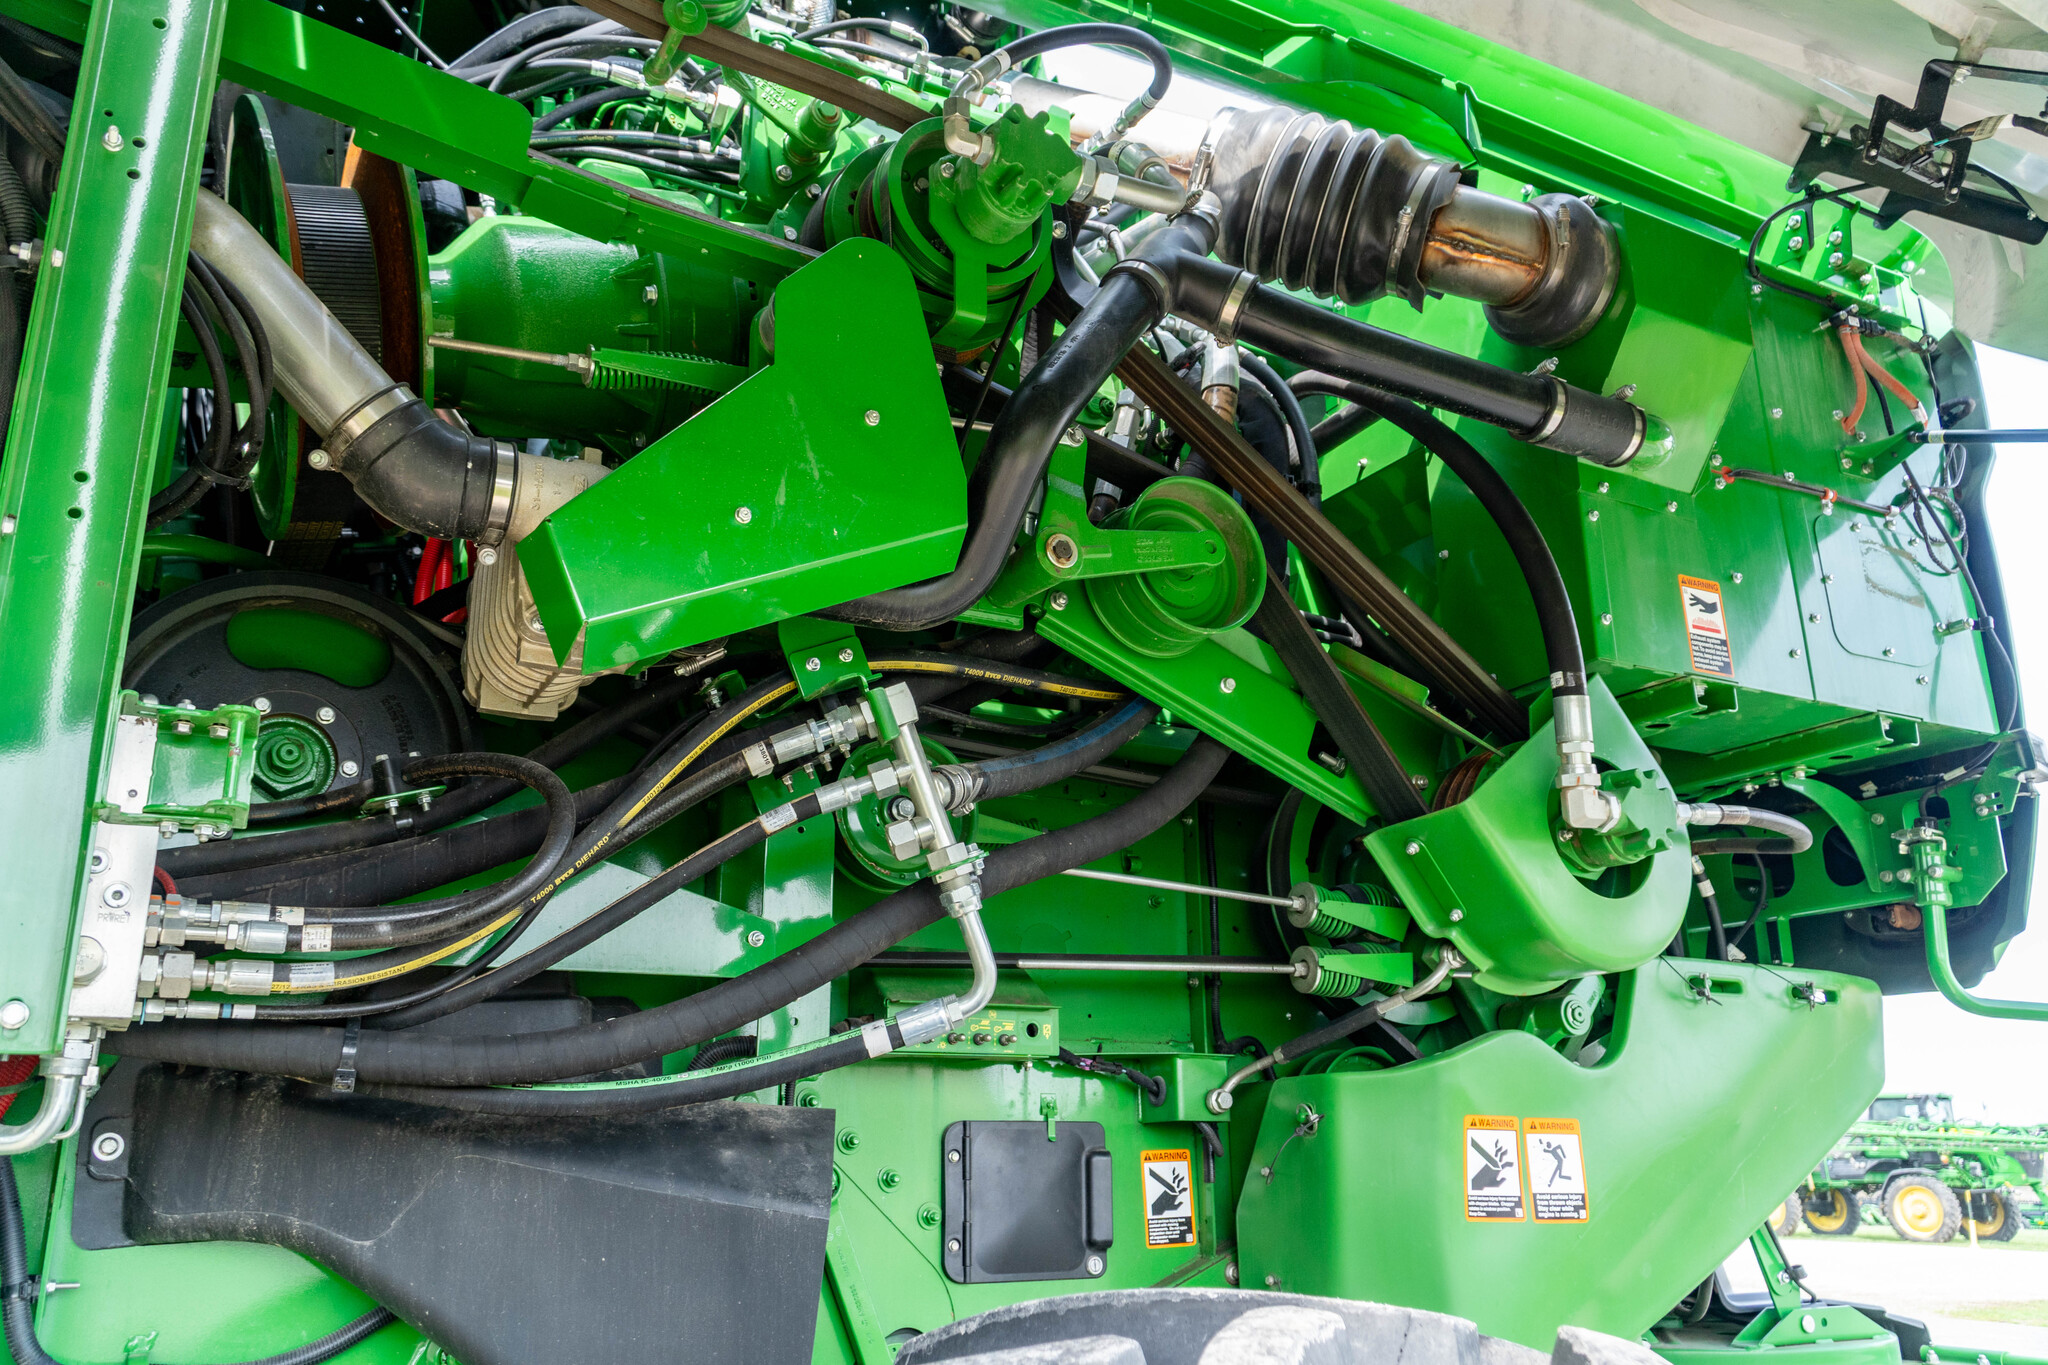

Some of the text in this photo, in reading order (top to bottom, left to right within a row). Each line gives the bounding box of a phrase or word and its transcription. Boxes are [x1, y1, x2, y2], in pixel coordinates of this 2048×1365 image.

[1687, 580, 1719, 592] WARNING
[964, 668, 984, 677] T4000
[641, 781, 665, 804] T4012D
[530, 884, 554, 904] T4000
[367, 966, 406, 980] RESISTANT
[1478, 1120, 1514, 1128] WARNING
[1540, 1122, 1574, 1130] WARNING
[1152, 1152, 1188, 1160] WARNING
